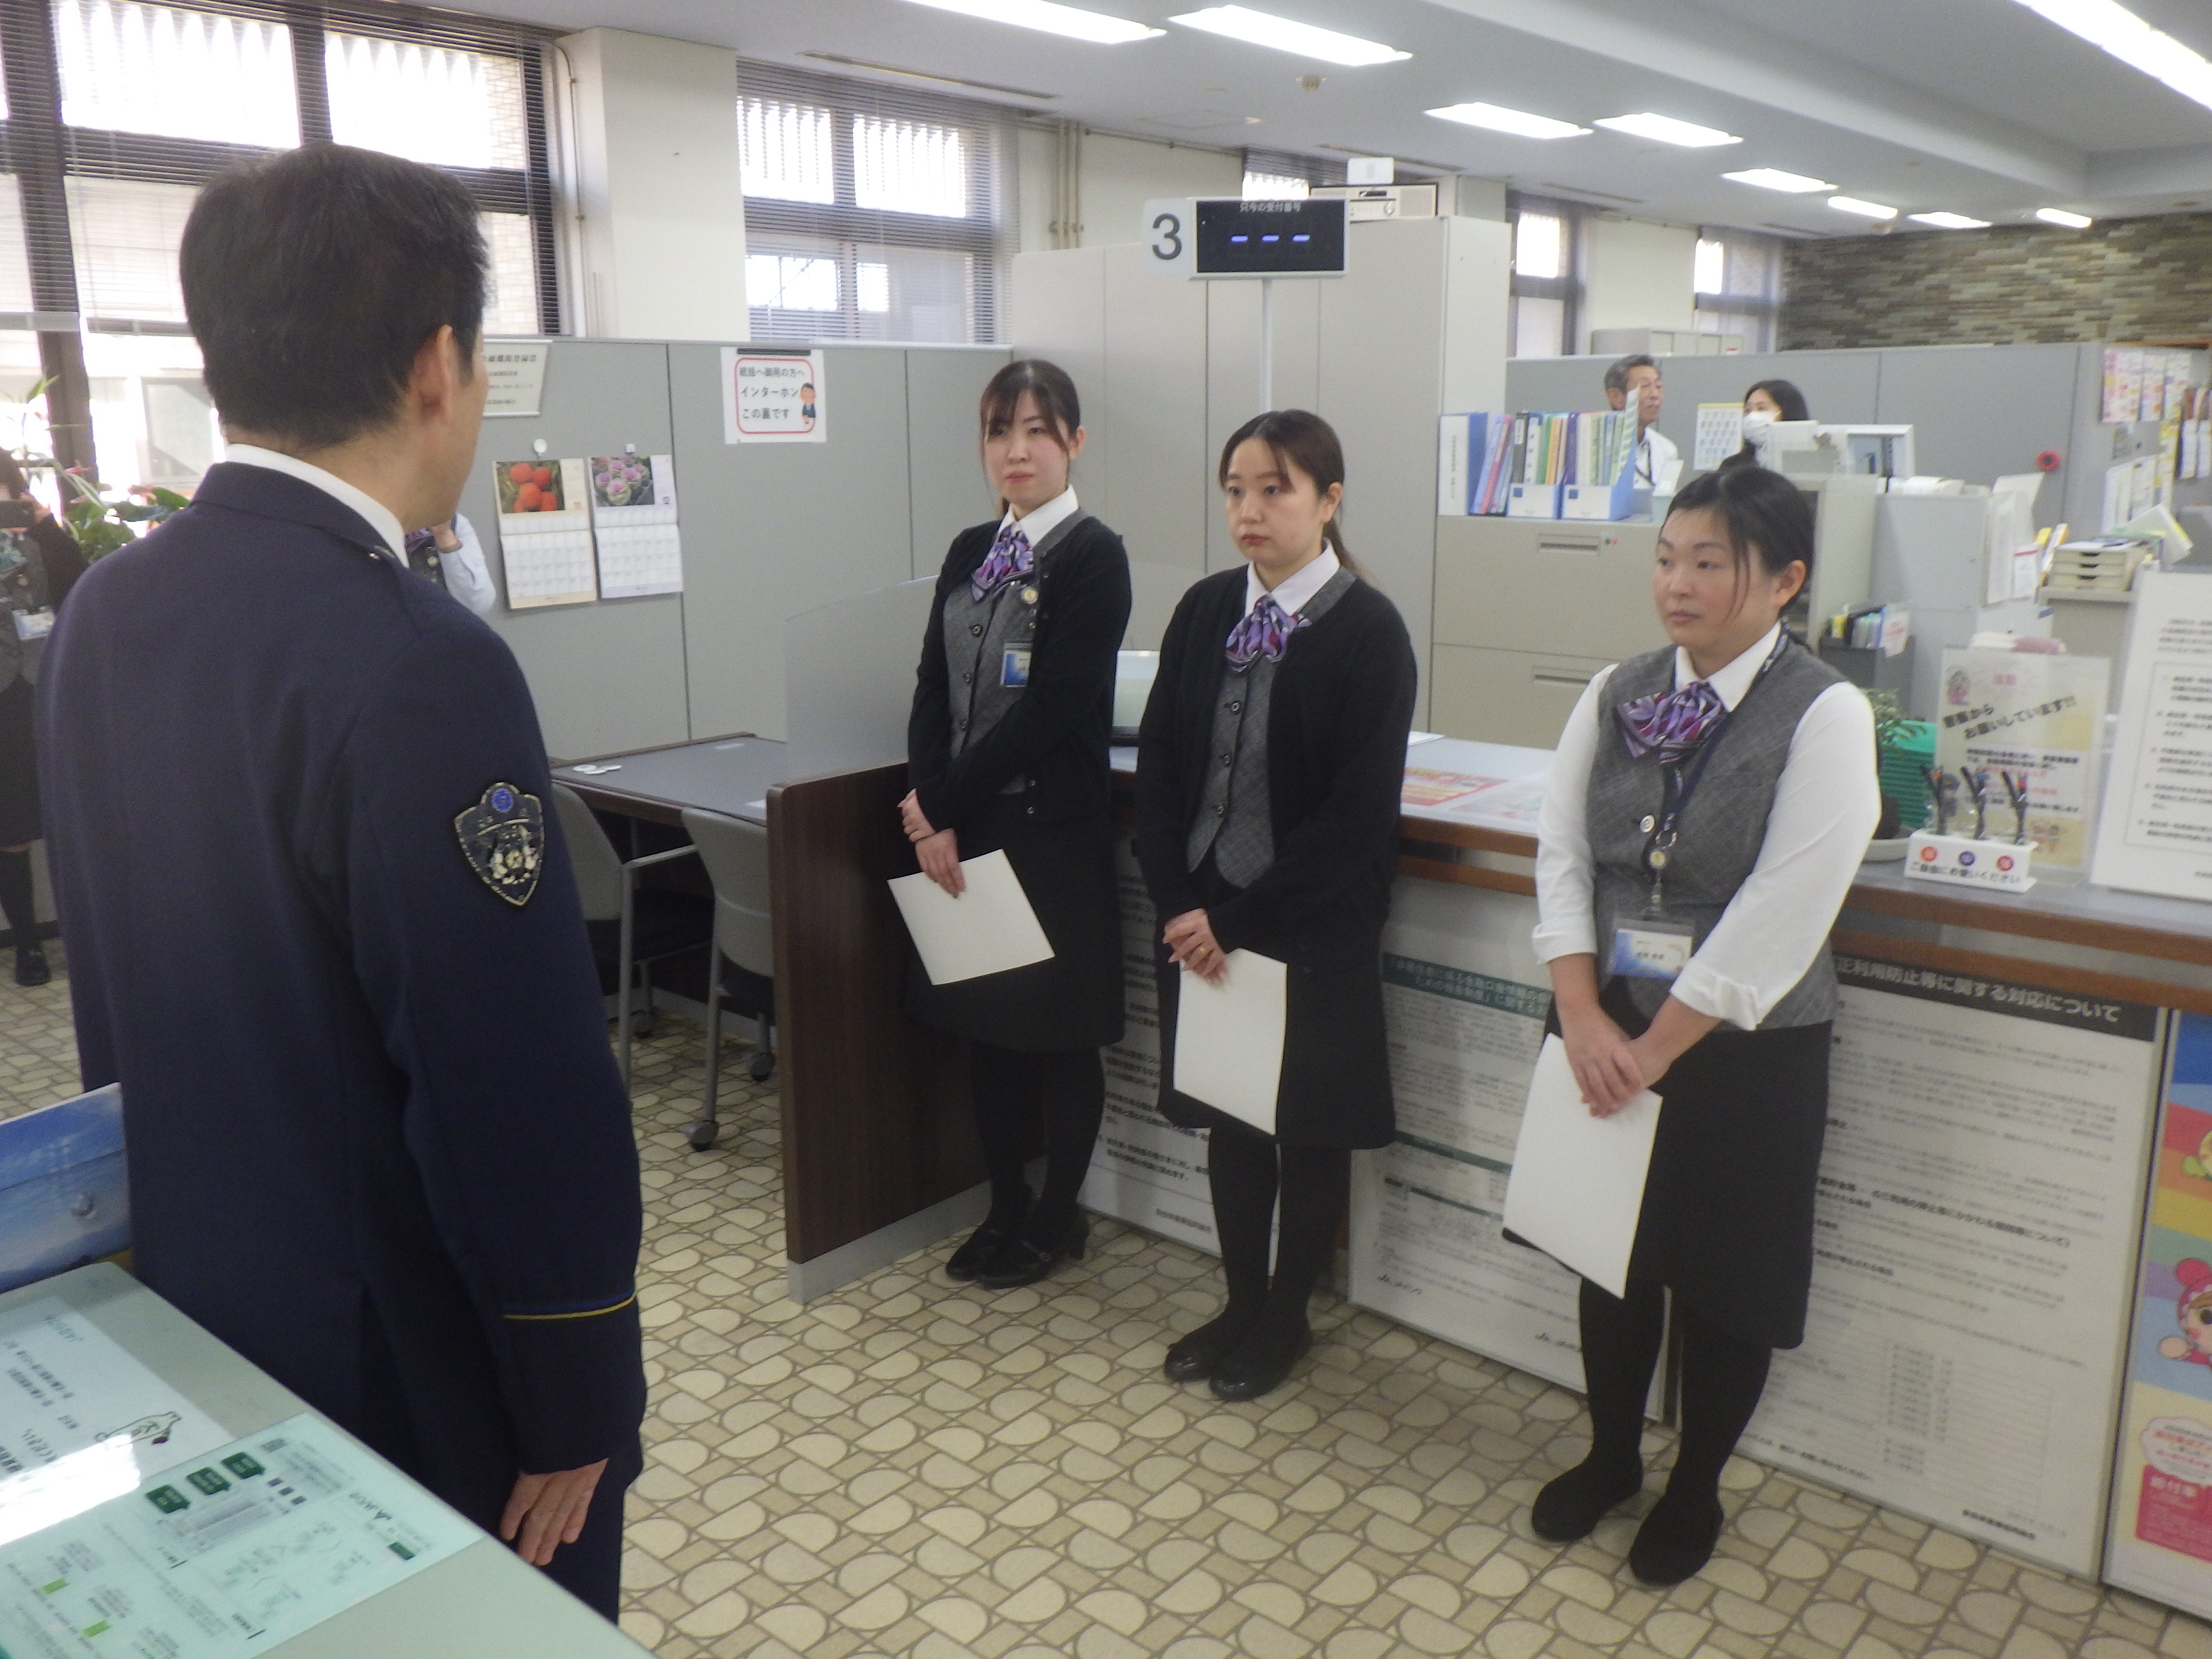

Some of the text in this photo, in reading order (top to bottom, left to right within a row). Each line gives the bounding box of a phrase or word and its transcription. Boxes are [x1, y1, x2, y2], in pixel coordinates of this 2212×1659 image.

[1153, 213, 1181, 260] 3
[741, 386, 798, 397] インターホン
